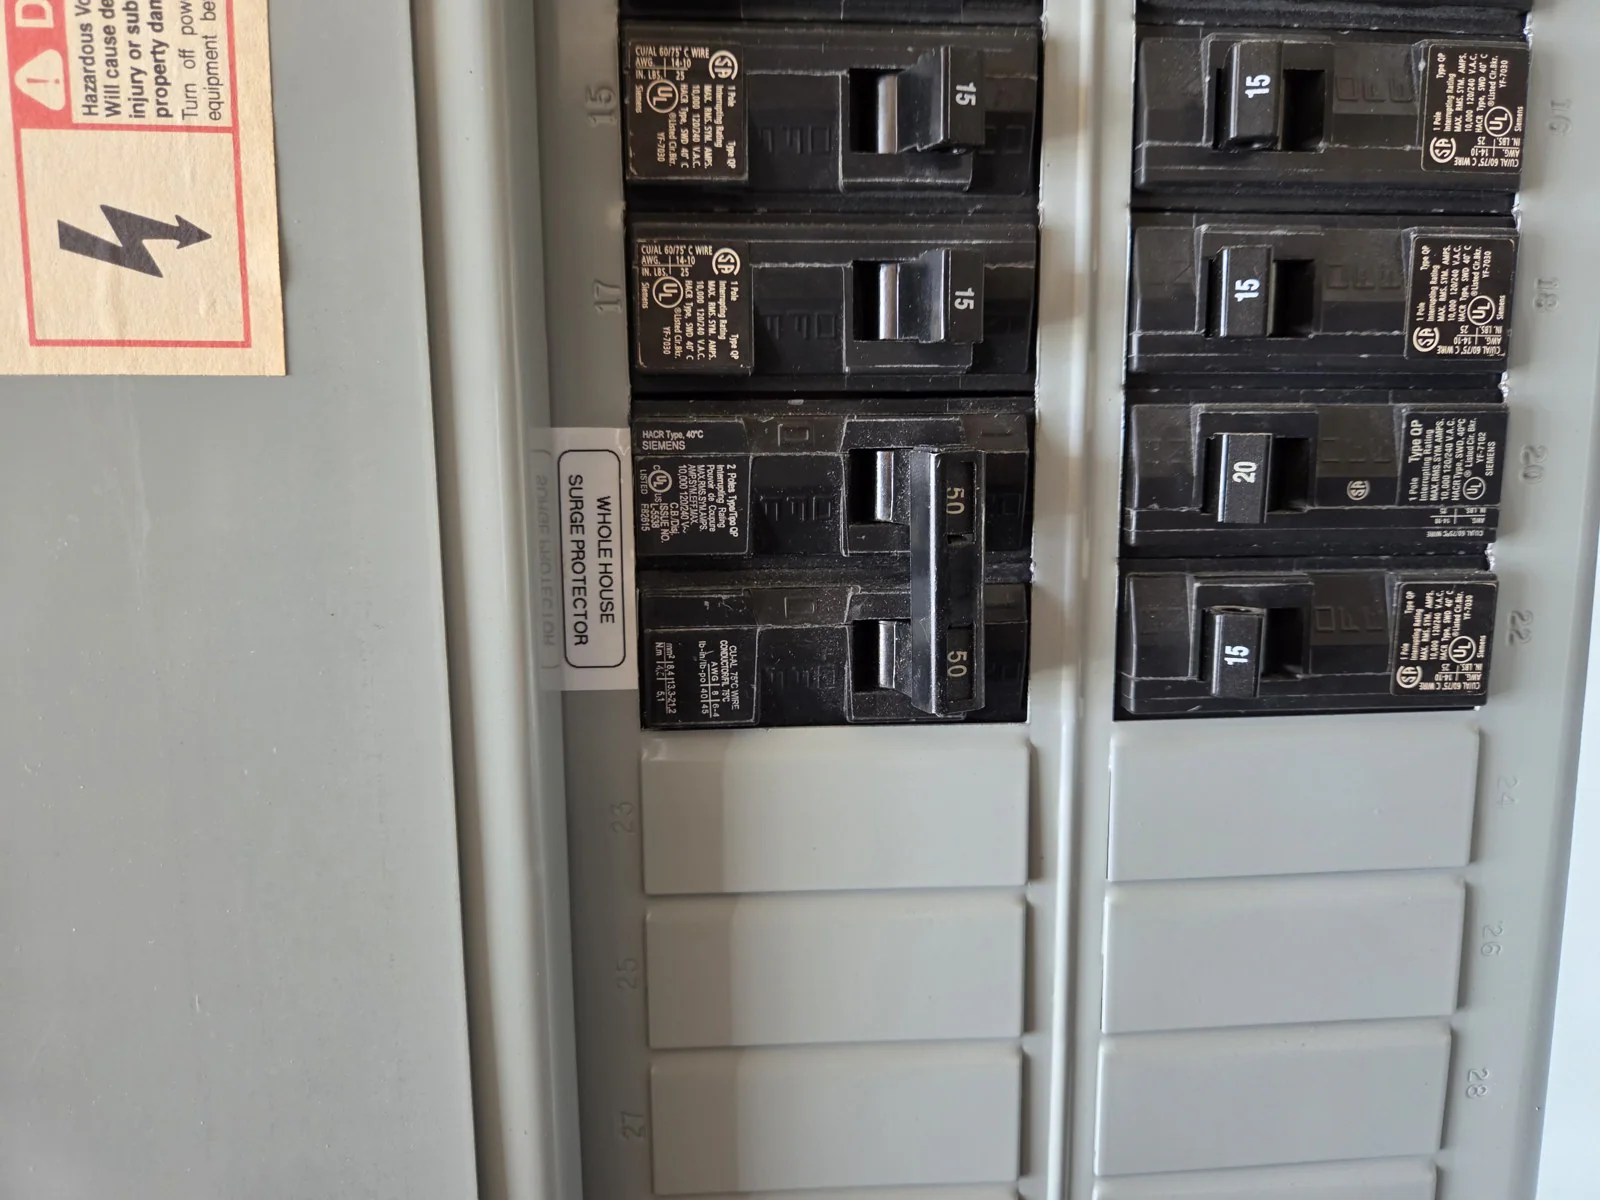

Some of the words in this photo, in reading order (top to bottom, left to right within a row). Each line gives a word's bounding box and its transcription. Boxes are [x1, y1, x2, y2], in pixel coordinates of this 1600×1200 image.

[15, 0, 54, 28] D
[180, 0, 198, 36] pow
[200, 0, 216, 21] be
[102, 24, 120, 79] cause
[128, 40, 142, 60] or
[178, 48, 196, 70] off
[1438, 53, 1447, 62] QP
[78, 22, 99, 116] Hazardous
[1436, 63, 1447, 78] Type
[1458, 53, 1467, 73] AMPS.
[1468, 54, 1477, 75] V.A.C.
[1499, 60, 1508, 88] YF-7030
[150, 38, 174, 118] property
[202, 34, 225, 122] equipment
[1245, 74, 1271, 99] 15
[1446, 73, 1456, 92] Rating
[1457, 78, 1465, 95] SYM.
[1478, 77, 1486, 91] SWD
[103, 84, 122, 118] Will
[128, 66, 150, 119] injury
[182, 83, 198, 121] Turn
[955, 82, 977, 106] 15
[1466, 78, 1475, 105] 120/240
[585, 85, 617, 127] 15
[1444, 94, 1455, 131] Interrupting
[1456, 97, 1464, 111] RMS.
[1475, 115, 1483, 133] HACR
[1514, 106, 1523, 131] Siemens
[1546, 100, 1571, 138] 16
[1471, 148, 1488, 156] 14-10
[1477, 137, 1486, 145] 25
[695, 246, 713, 255] WIRE
[681, 268, 689, 276] 25
[1482, 251, 1492, 278] YF-7030
[594, 279, 623, 314] 17
[954, 287, 975, 310] 15
[1234, 278, 1260, 301] 15
[1533, 277, 1560, 314] 18
[685, 323, 693, 338] SWD
[697, 309, 705, 335] 120/240
[718, 319, 727, 340] Rating
[663, 326, 671, 354] YF-7030
[709, 340, 717, 360] AMPS.
[729, 334, 739, 349] Type
[730, 351, 739, 359] QP
[1410, 419, 1423, 435] QP
[642, 441, 685, 450] SIEMENS
[1409, 440, 1423, 463] Type
[1423, 429, 1434, 454] Rating
[1476, 432, 1487, 463] YF-7102
[1443, 444, 1452, 473] 120/240
[1465, 446, 1475, 468] Listed
[1485, 442, 1496, 476] SIEMENS
[1520, 443, 1547, 485] 20
[640, 469, 648, 495] LISTED
[678, 465, 688, 489] 10,000
[716, 464, 724, 504] Interrupting
[727, 472, 737, 494] Poles
[1233, 461, 1258, 483] 20
[1419, 456, 1432, 501] Interrupting
[708, 492, 714, 501] de
[946, 487, 965, 516] 50
[1452, 479, 1460, 501] HACR
[568, 474, 585, 535] SURGE
[650, 504, 660, 528] L-5538
[660, 503, 669, 527] ISSUE
[680, 490, 689, 520] 120/240
[597, 496, 613, 559] WHOLE
[717, 507, 726, 528] Rating
[661, 528, 670, 543] NO.
[729, 528, 739, 537] QP
[571, 540, 589, 646] PROTECTOR
[598, 562, 615, 624] HOUSE
[1505, 610, 1534, 647] 22
[729, 646, 738, 668] CU-AL
[948, 650, 968, 678] 50
[1224, 645, 1250, 665] 15
[711, 662, 719, 681] AWG
[701, 688, 708, 699] 40
[731, 690, 740, 710] WIRE
[701, 703, 708, 714] 45
[1496, 775, 1518, 808] 24
[612, 801, 635, 835] 23
[1480, 921, 1503, 956] 26
[616, 956, 639, 991] 25
[1465, 1066, 1489, 1099] 28
[621, 1110, 646, 1141] 27
